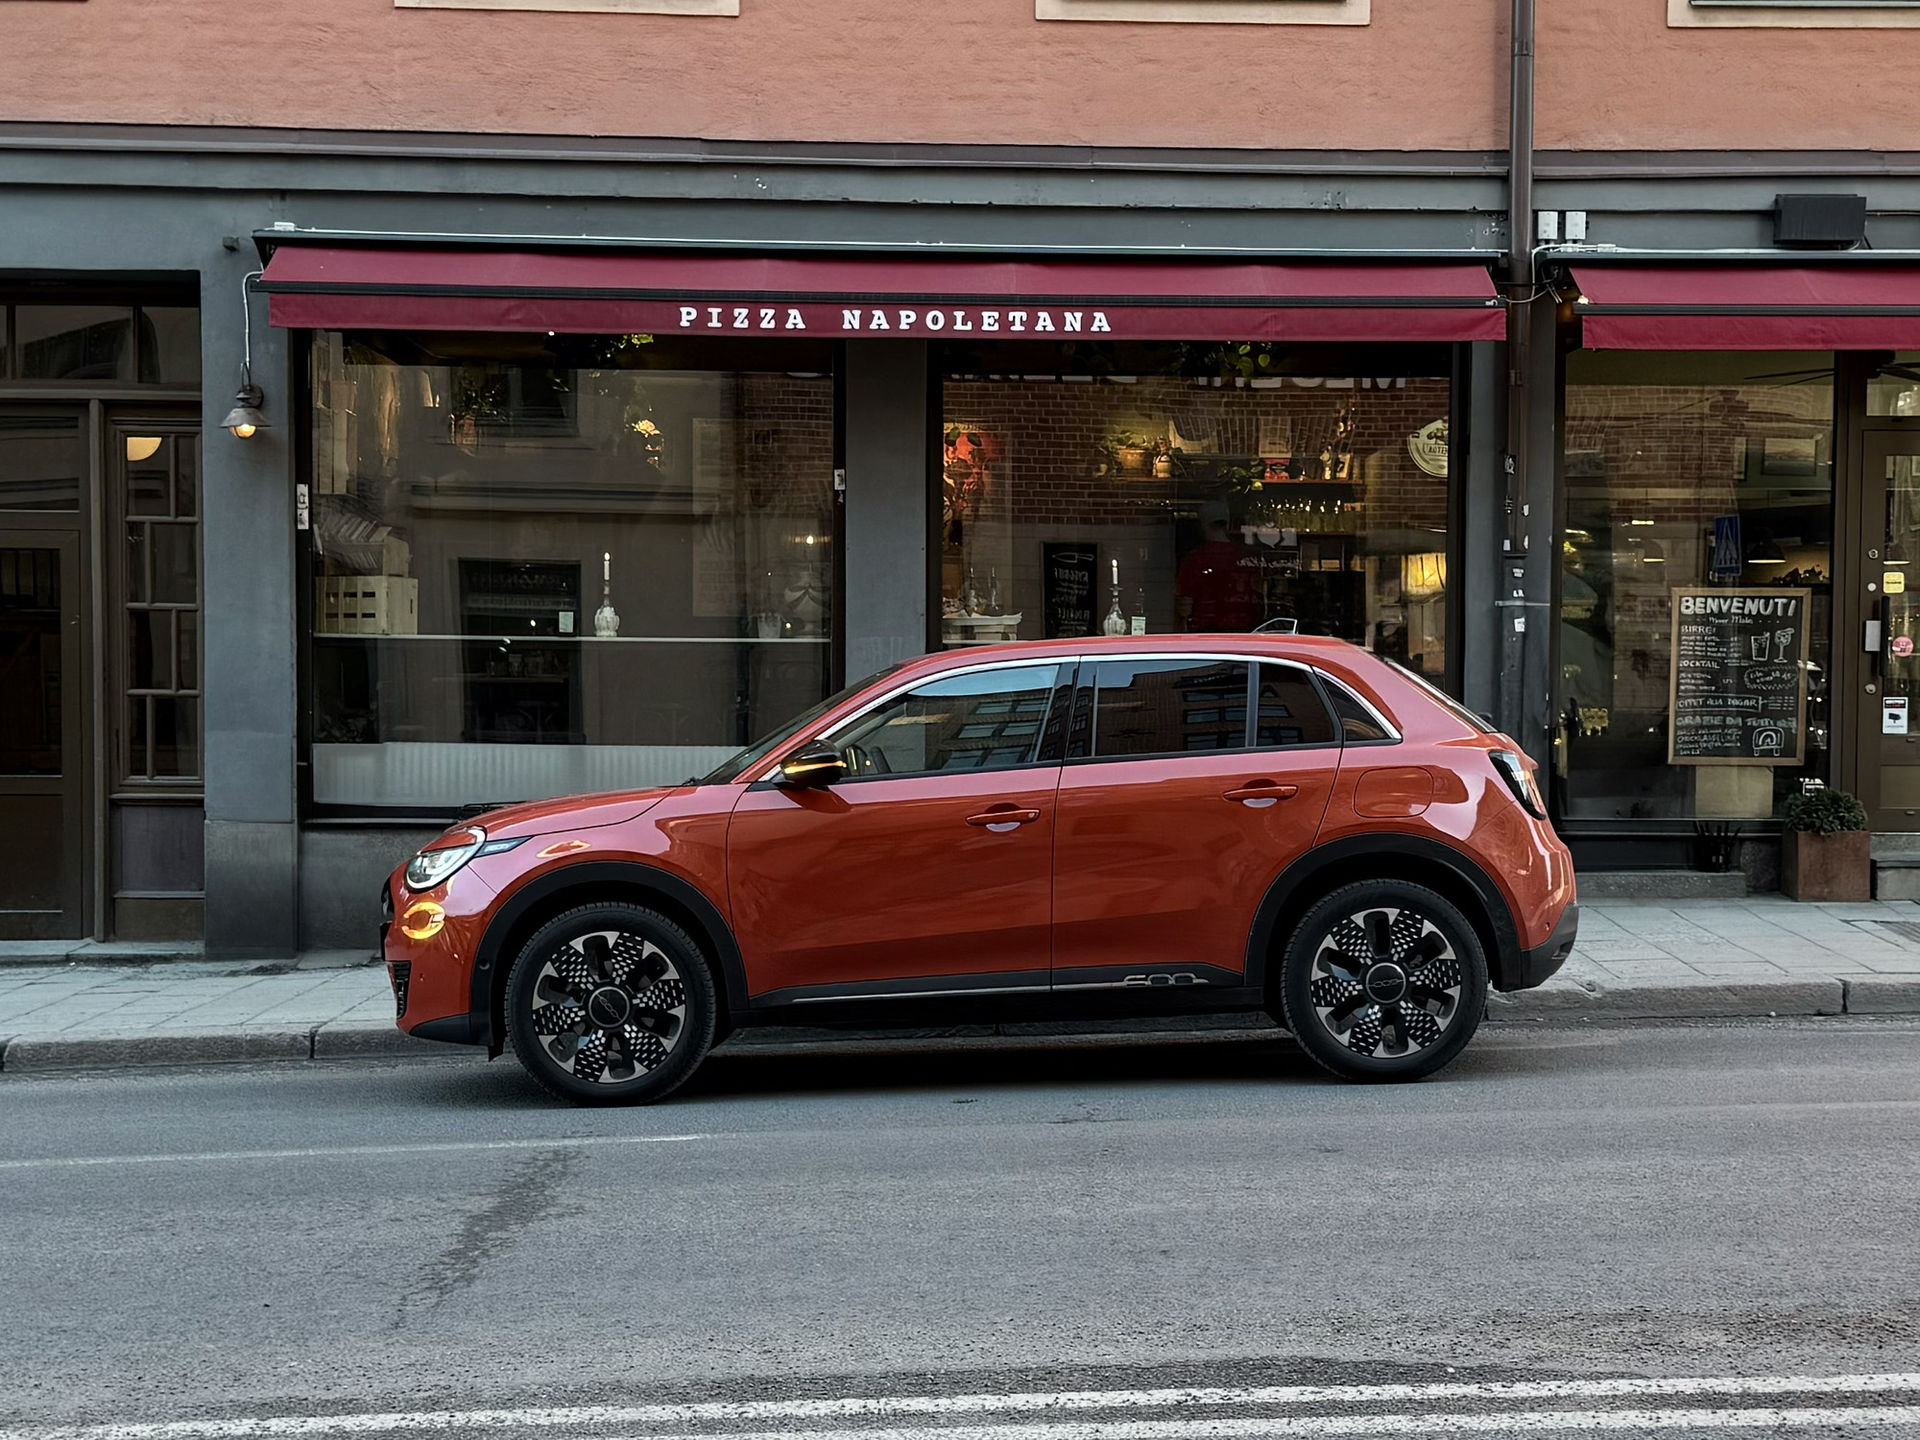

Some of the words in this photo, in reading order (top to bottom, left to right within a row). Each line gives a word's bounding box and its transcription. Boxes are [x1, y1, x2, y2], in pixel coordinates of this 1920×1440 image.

[679, 306, 806, 330] PIZZA
[842, 309, 1112, 333] NAPOLETANA
[1680, 597, 1797, 617] BENVENUTI
